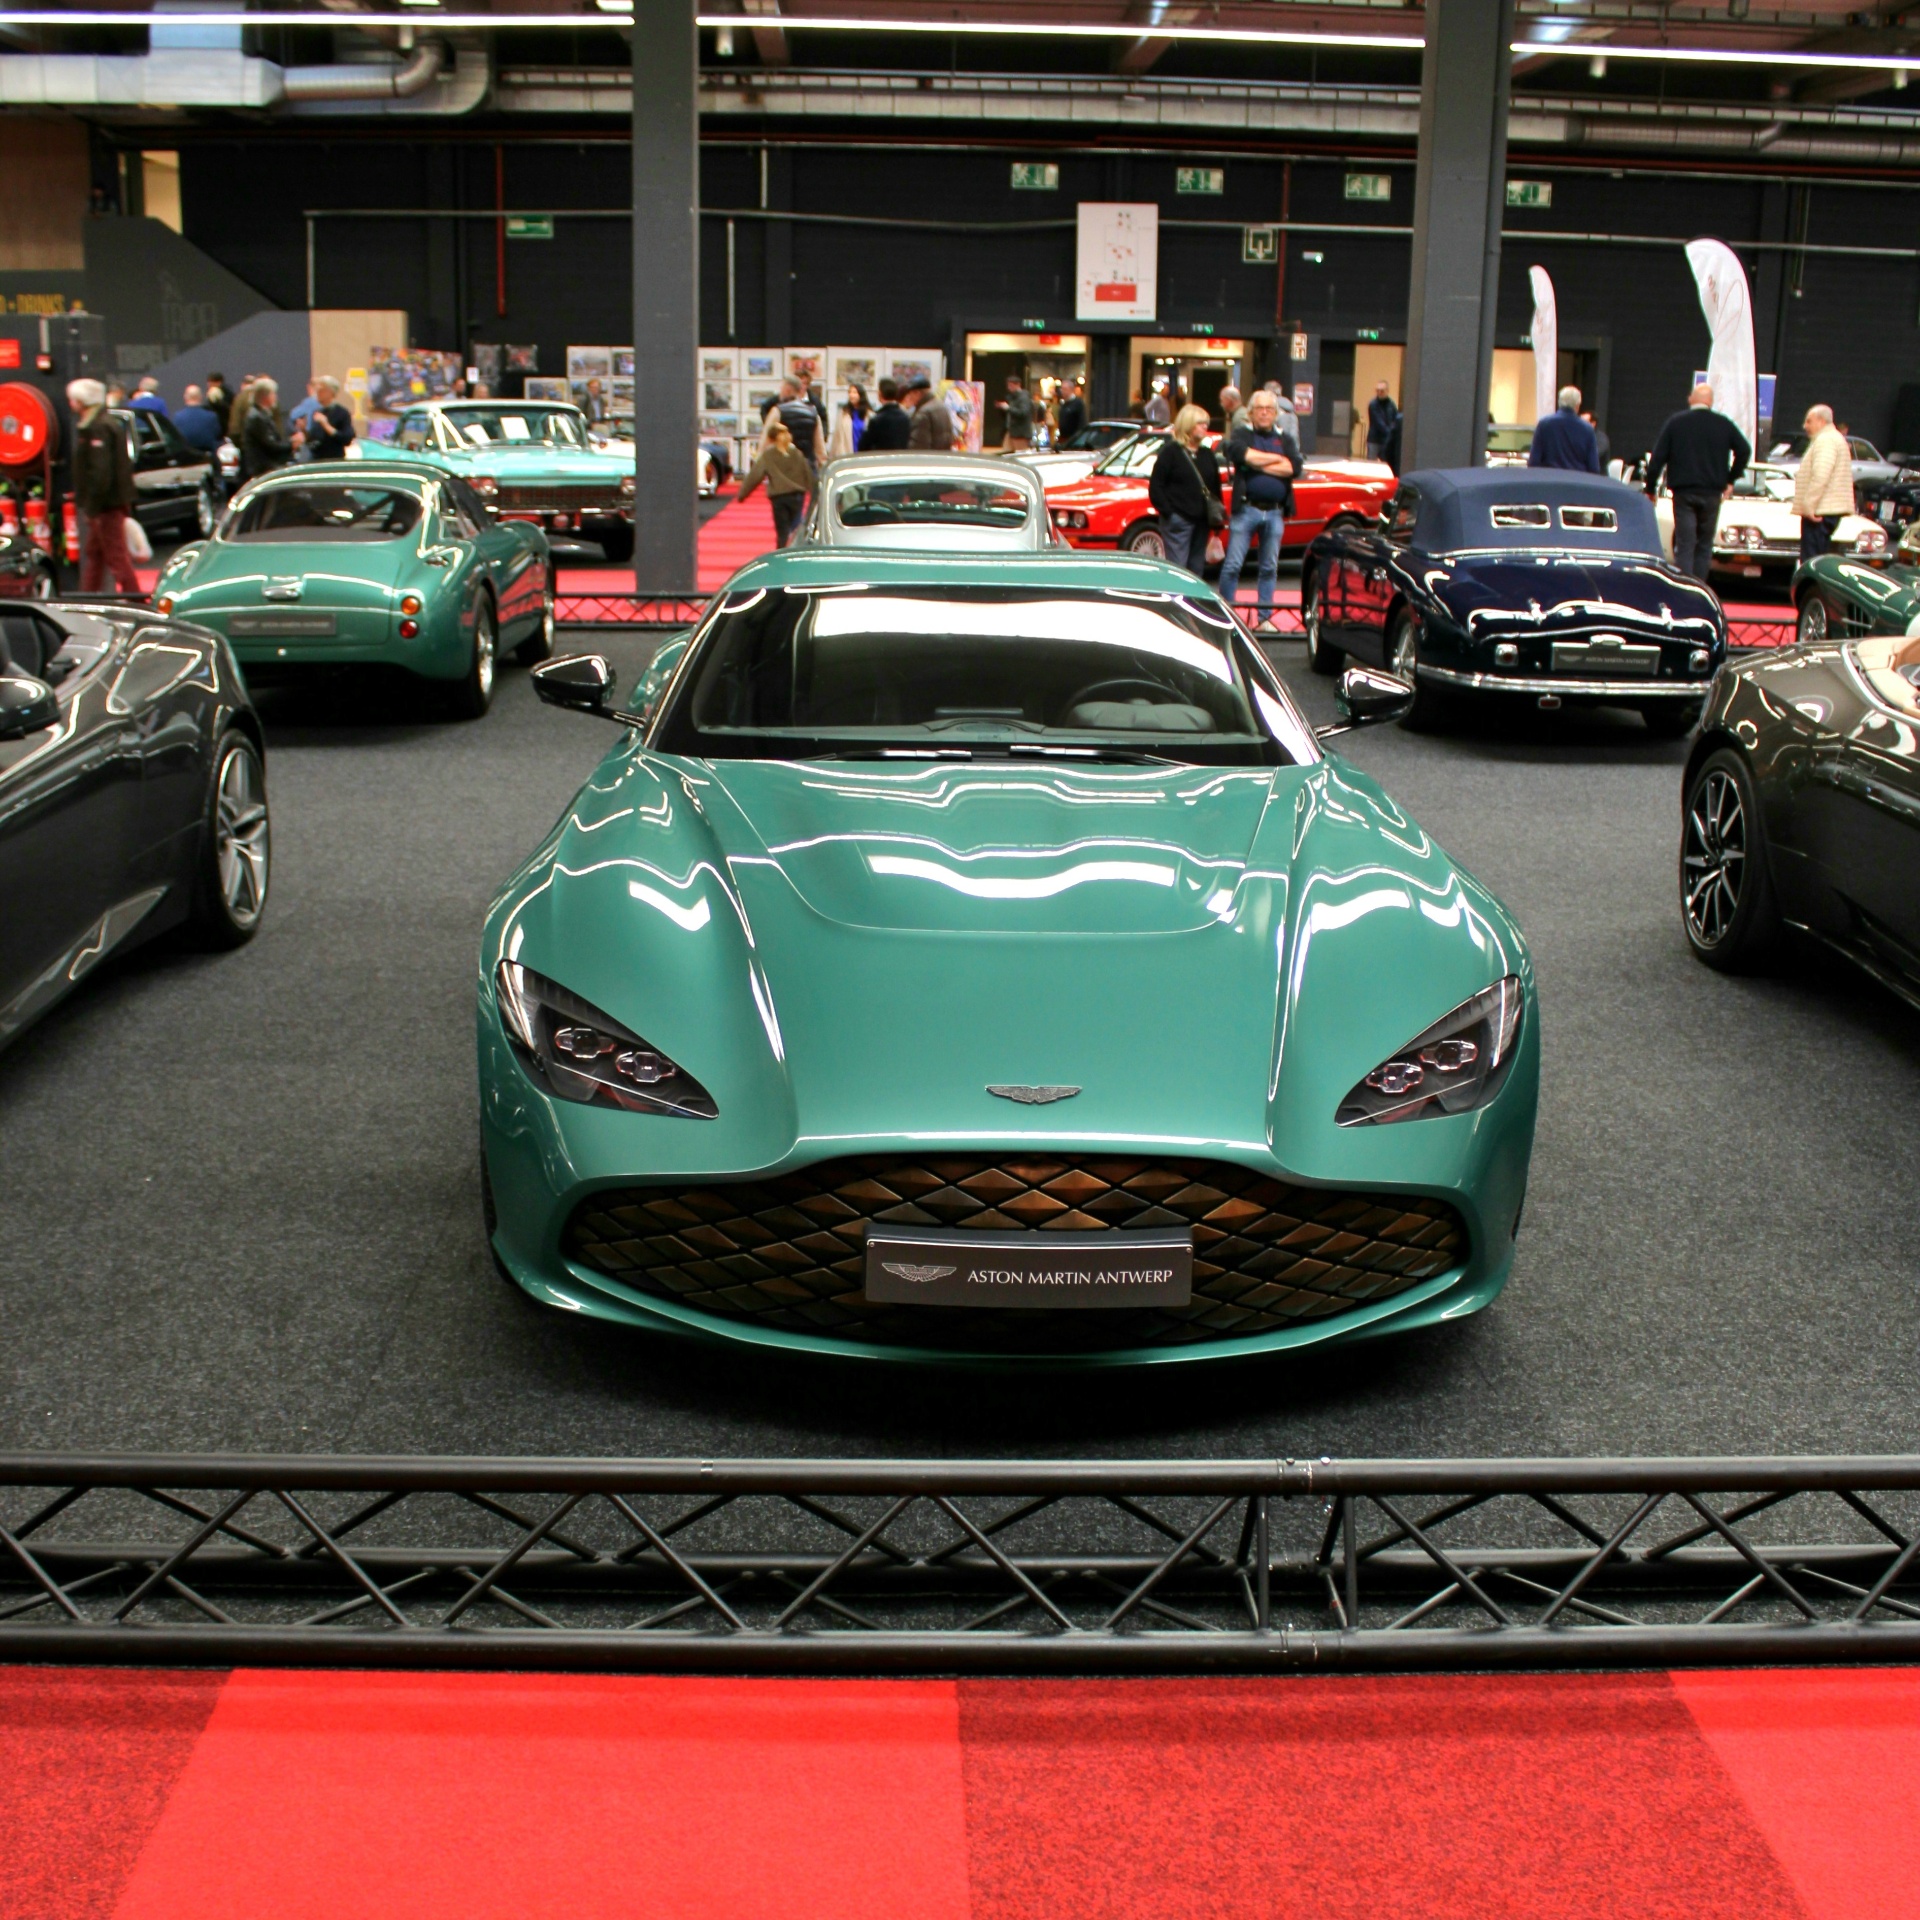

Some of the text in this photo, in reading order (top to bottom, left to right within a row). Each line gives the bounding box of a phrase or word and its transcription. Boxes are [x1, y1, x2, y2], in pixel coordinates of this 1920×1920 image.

[967, 1269, 1173, 1285] ASTON MARTIN ANTWERP
